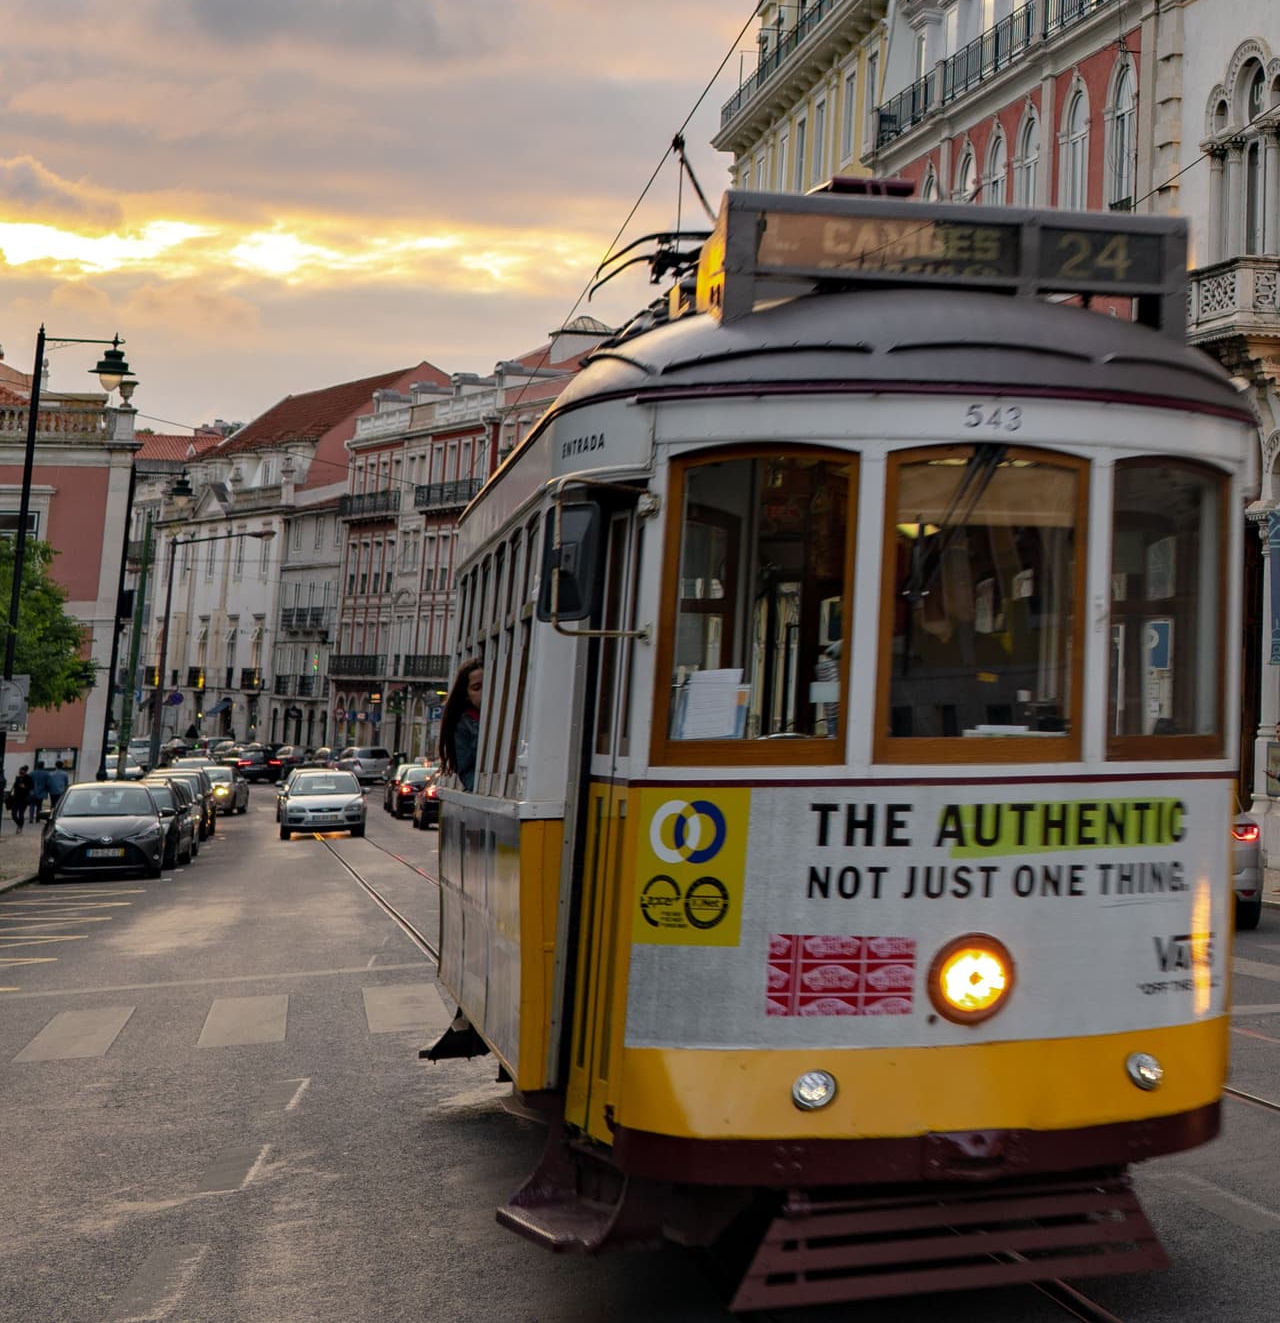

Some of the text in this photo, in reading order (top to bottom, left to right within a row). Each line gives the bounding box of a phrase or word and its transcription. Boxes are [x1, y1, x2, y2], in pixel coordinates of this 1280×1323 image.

[1056, 232, 1134, 280] 24
[963, 403, 1023, 432] 543
[561, 432, 606, 460] ENTRADA
[811, 800, 1188, 848] THE AUTHENTIC
[806, 861, 1191, 900] NOT JUST ONE THING.
